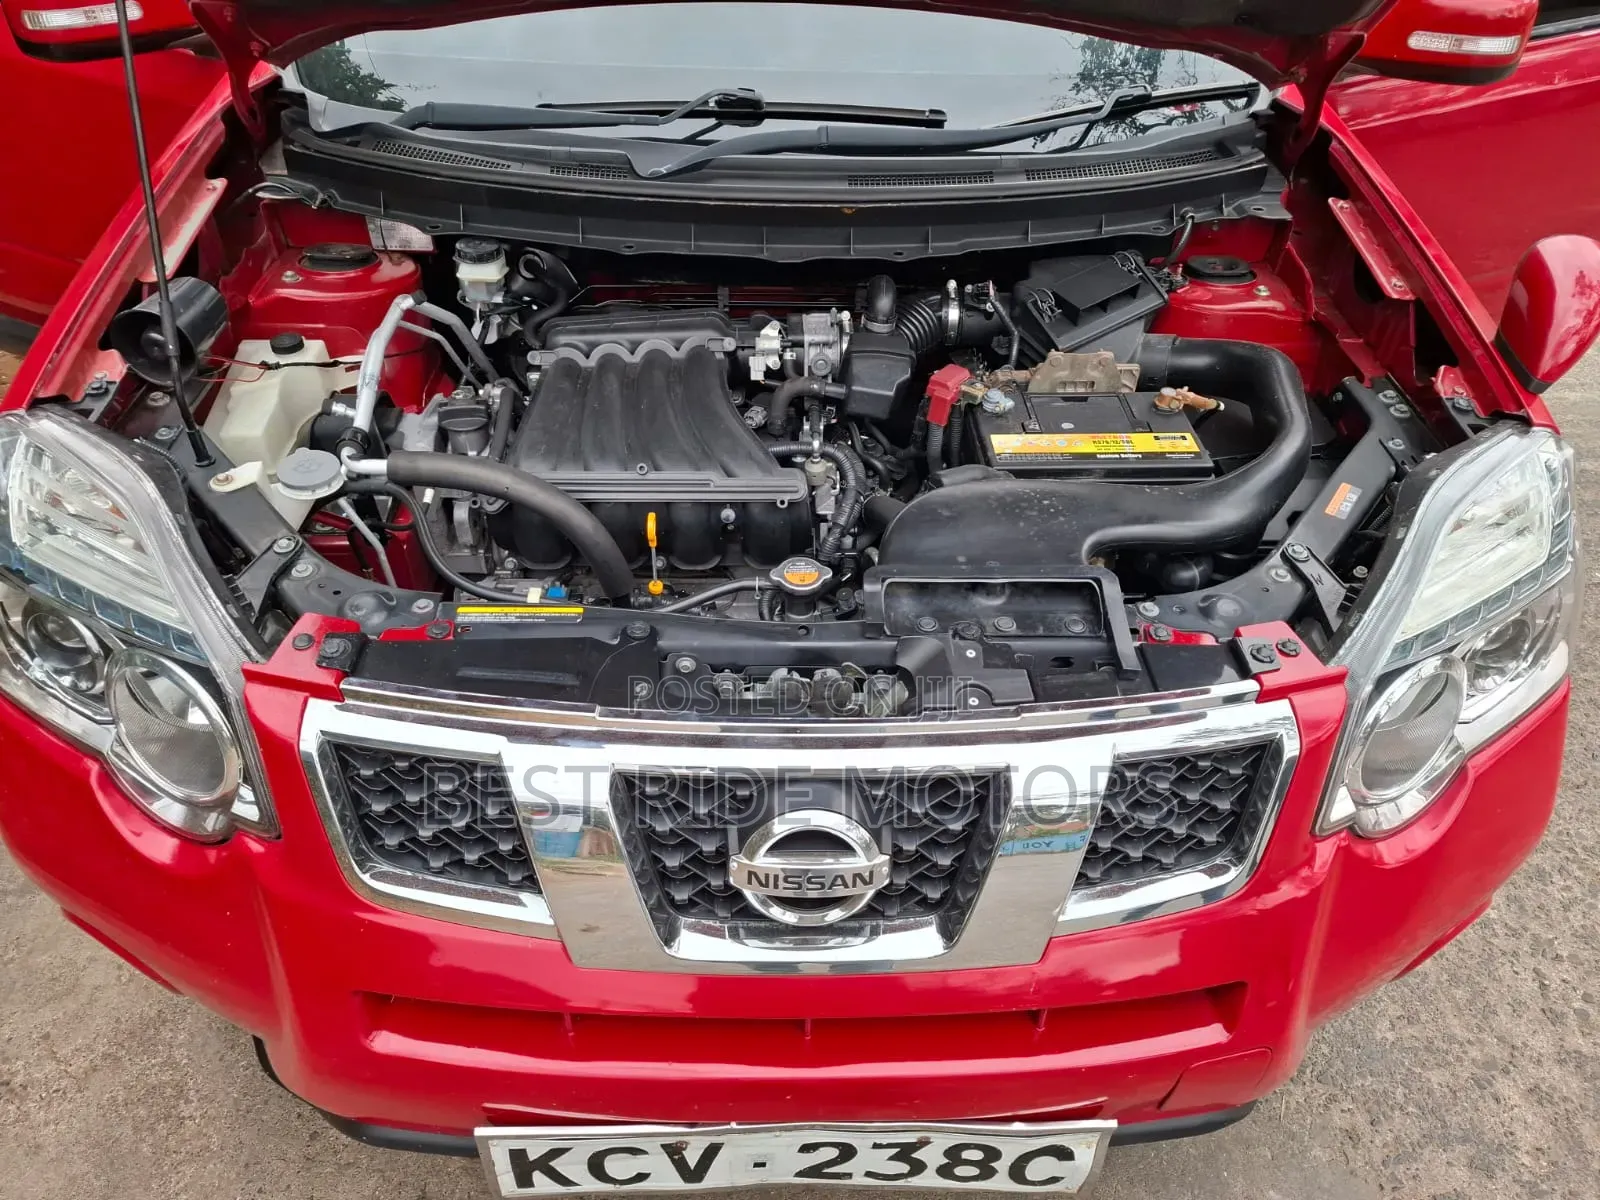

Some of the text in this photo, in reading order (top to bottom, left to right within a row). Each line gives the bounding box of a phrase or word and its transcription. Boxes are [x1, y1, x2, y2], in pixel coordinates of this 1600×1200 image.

[747, 870, 874, 891] NISSAN
[508, 1137, 1076, 1188] KCV 238C
